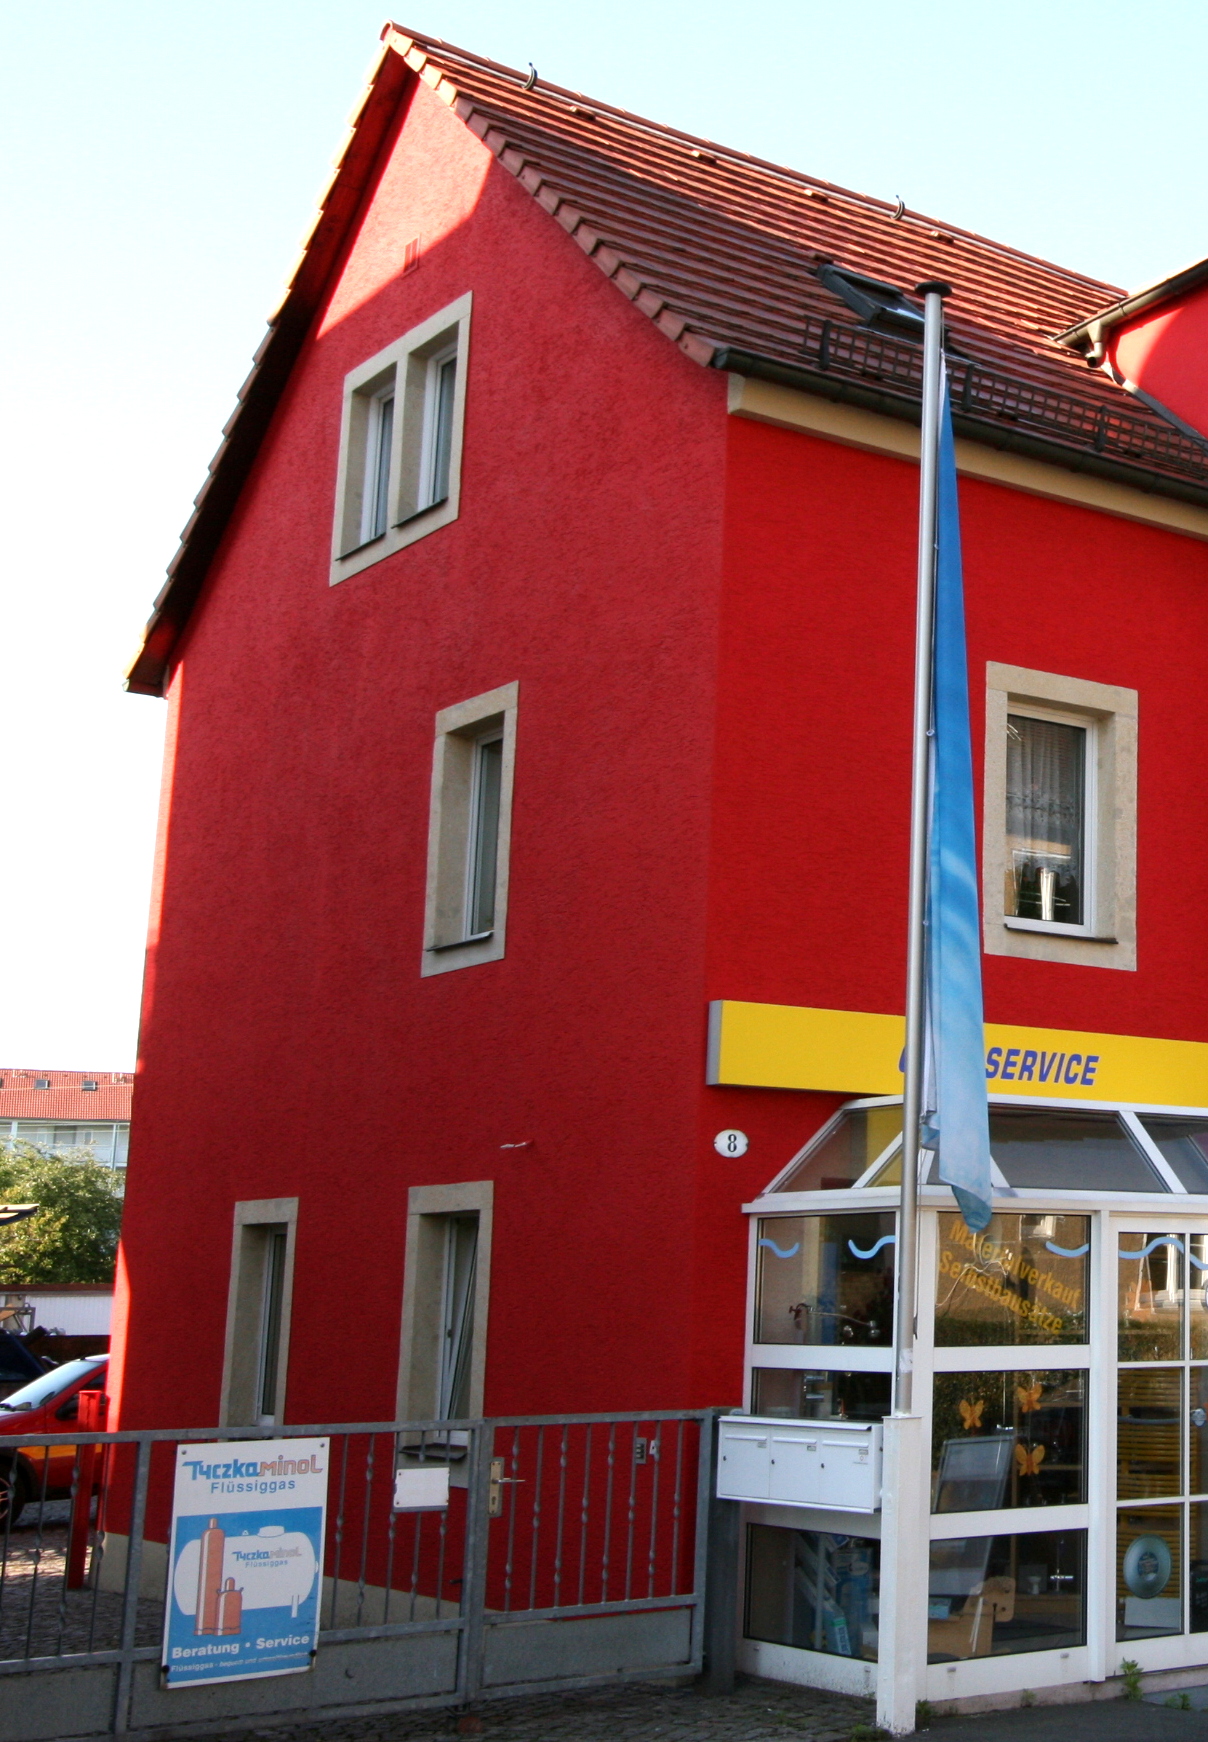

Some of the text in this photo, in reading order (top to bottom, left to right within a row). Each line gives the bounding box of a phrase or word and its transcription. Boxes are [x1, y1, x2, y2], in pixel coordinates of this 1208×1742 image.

[985, 1047, 1100, 1086] SERVICE
[728, 1134, 737, 1152] 8
[210, 1480, 296, 1494] Flüssiggas
[172, 1635, 309, 1659] Beratung Service
